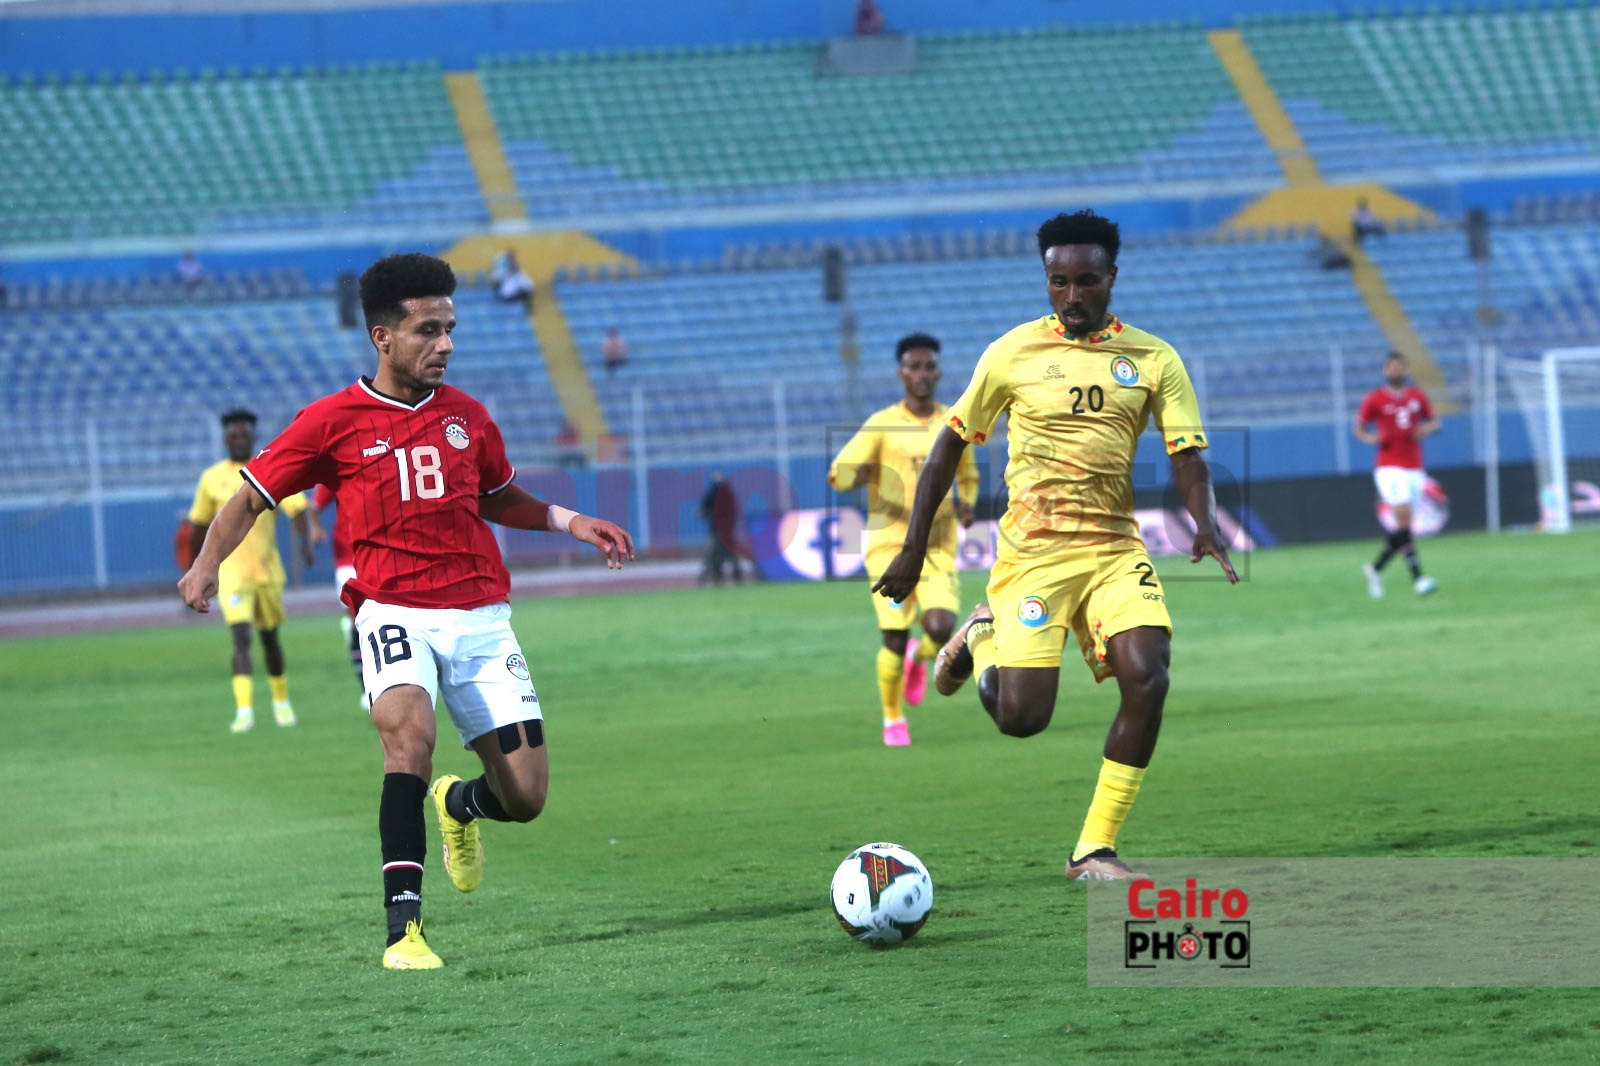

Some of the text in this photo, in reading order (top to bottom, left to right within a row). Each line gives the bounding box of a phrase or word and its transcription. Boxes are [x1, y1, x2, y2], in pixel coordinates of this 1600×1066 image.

[1068, 384, 1105, 415] 20
[362, 444, 387, 458] PUMA
[394, 445, 445, 501] 18
[1134, 561, 1158, 588] 2
[368, 624, 412, 674] 18
